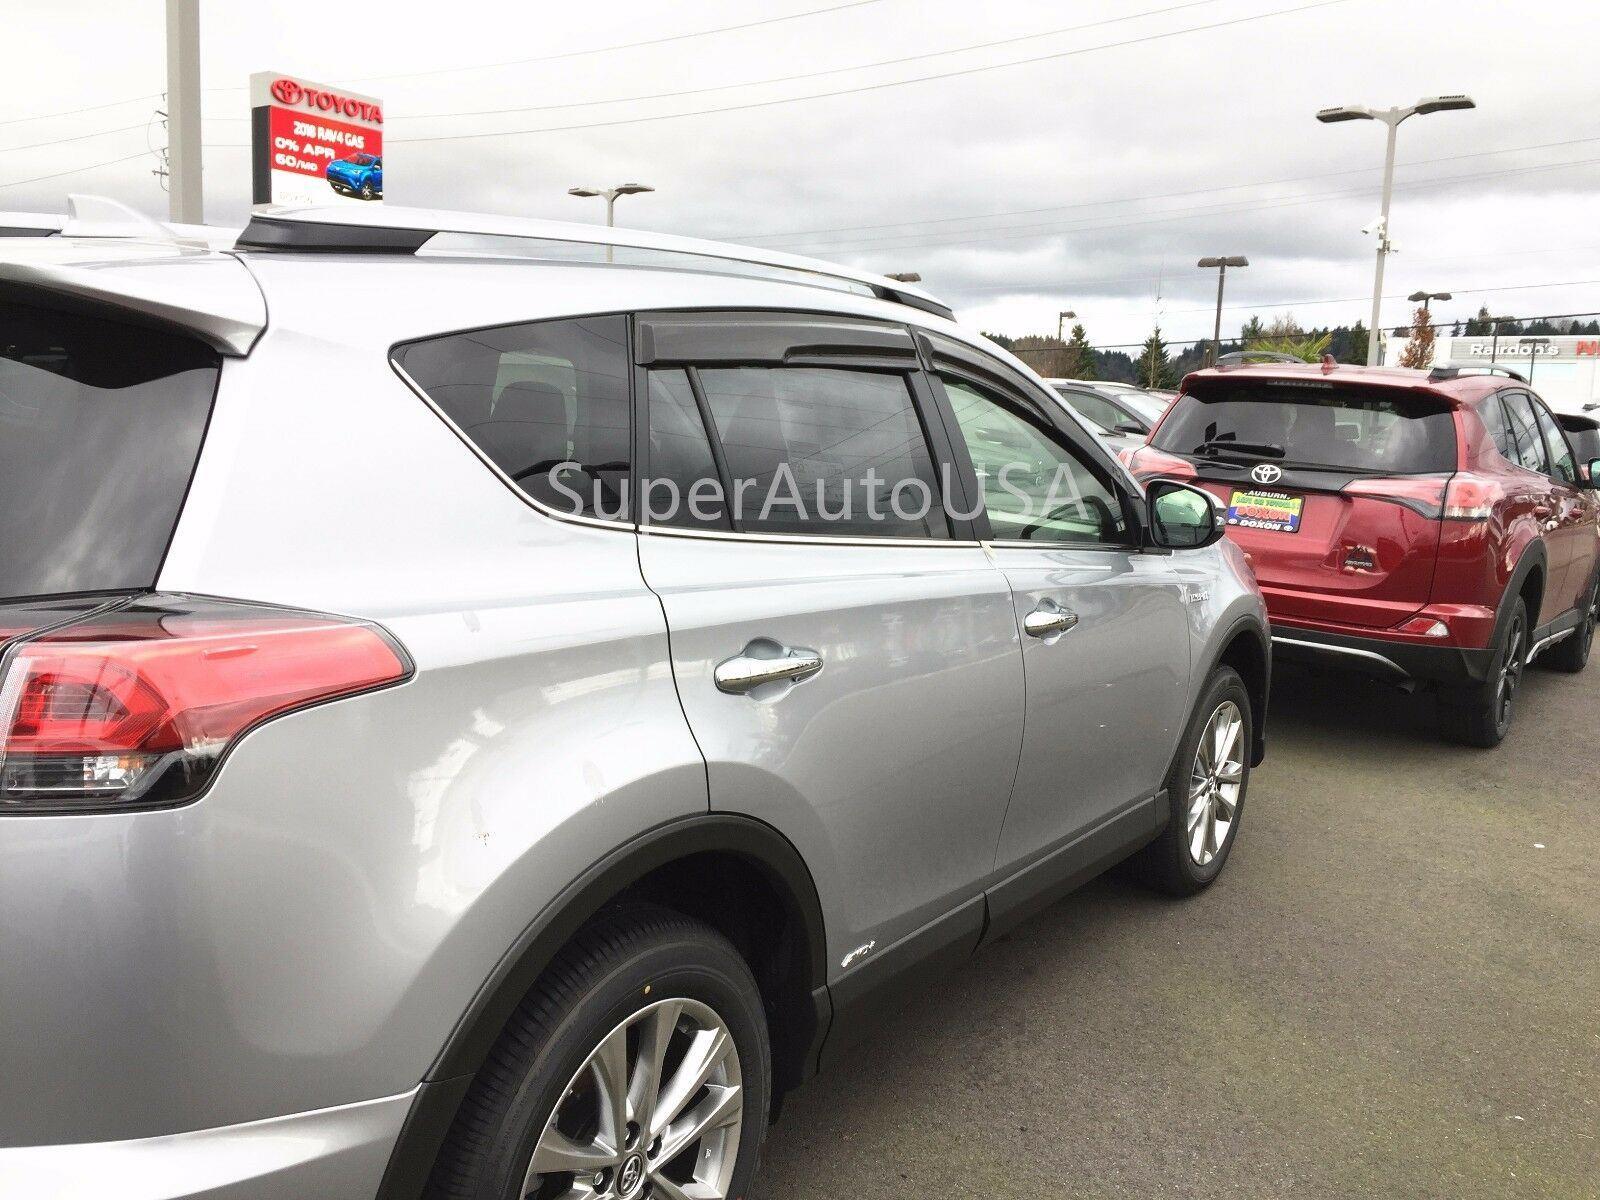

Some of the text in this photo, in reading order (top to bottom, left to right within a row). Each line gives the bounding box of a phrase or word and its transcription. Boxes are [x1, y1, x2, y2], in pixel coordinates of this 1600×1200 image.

[303, 87, 383, 123] TOYOTA
[274, 136, 336, 159] 0% APR
[344, 132, 364, 149] GAS
[1470, 342, 1560, 356] Rairdon's
[1248, 490, 1288, 499] AUBURN
[1239, 519, 1282, 531] DOXON
